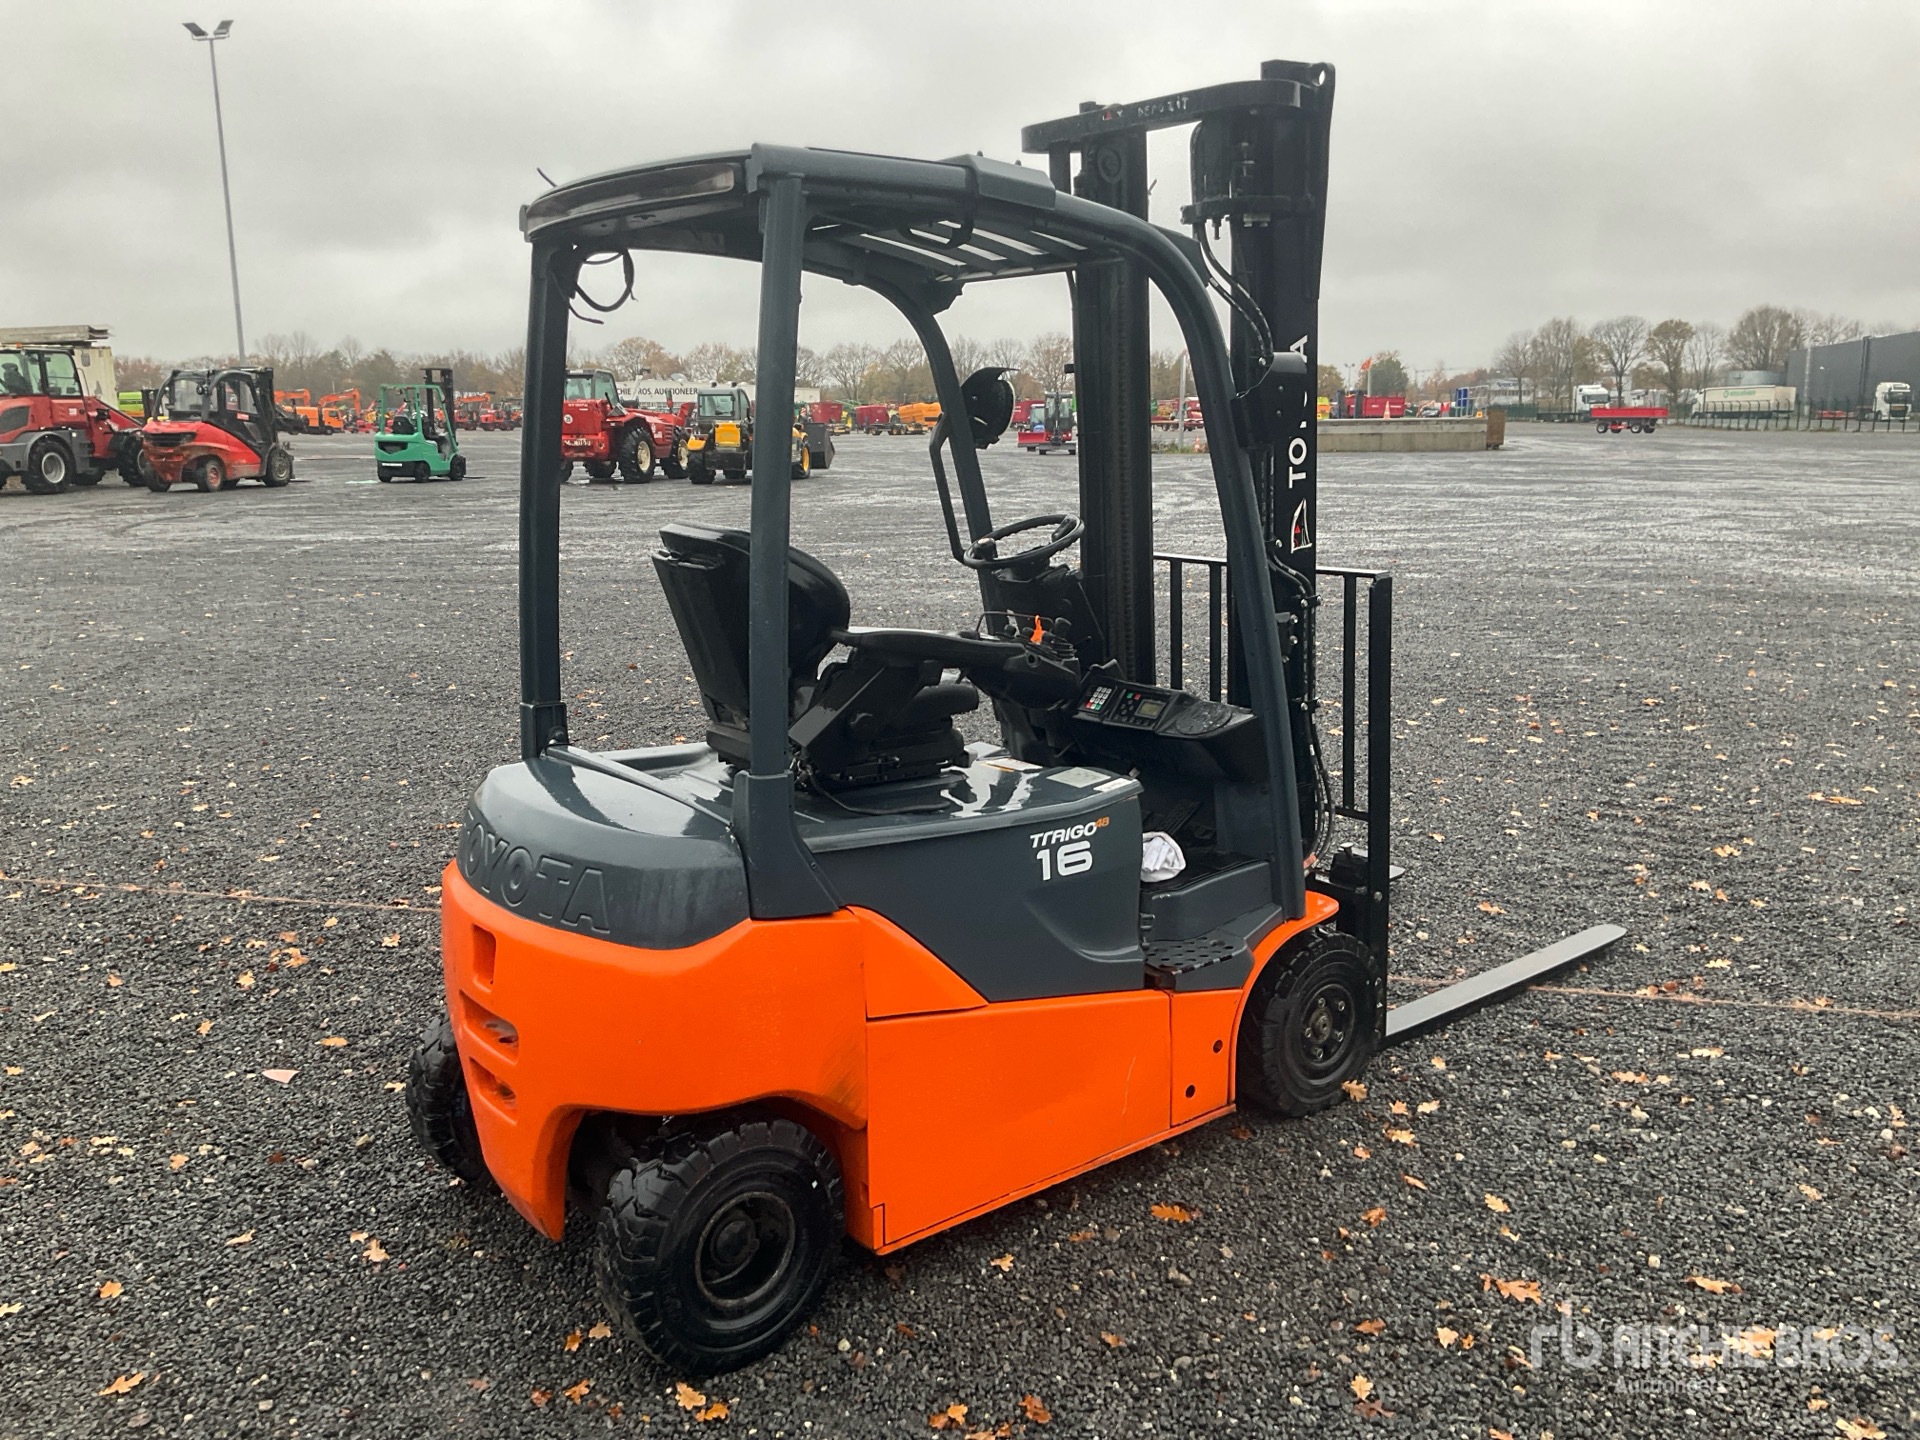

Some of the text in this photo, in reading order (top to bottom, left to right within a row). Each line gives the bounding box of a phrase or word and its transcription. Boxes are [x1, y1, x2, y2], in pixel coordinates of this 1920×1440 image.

[617, 387, 631, 395] CHIE
[654, 387, 698, 395] AUCIONEER
[1288, 334, 1308, 489] TOA
[464, 809, 611, 934] OYOTA
[1036, 840, 1093, 881] 16
